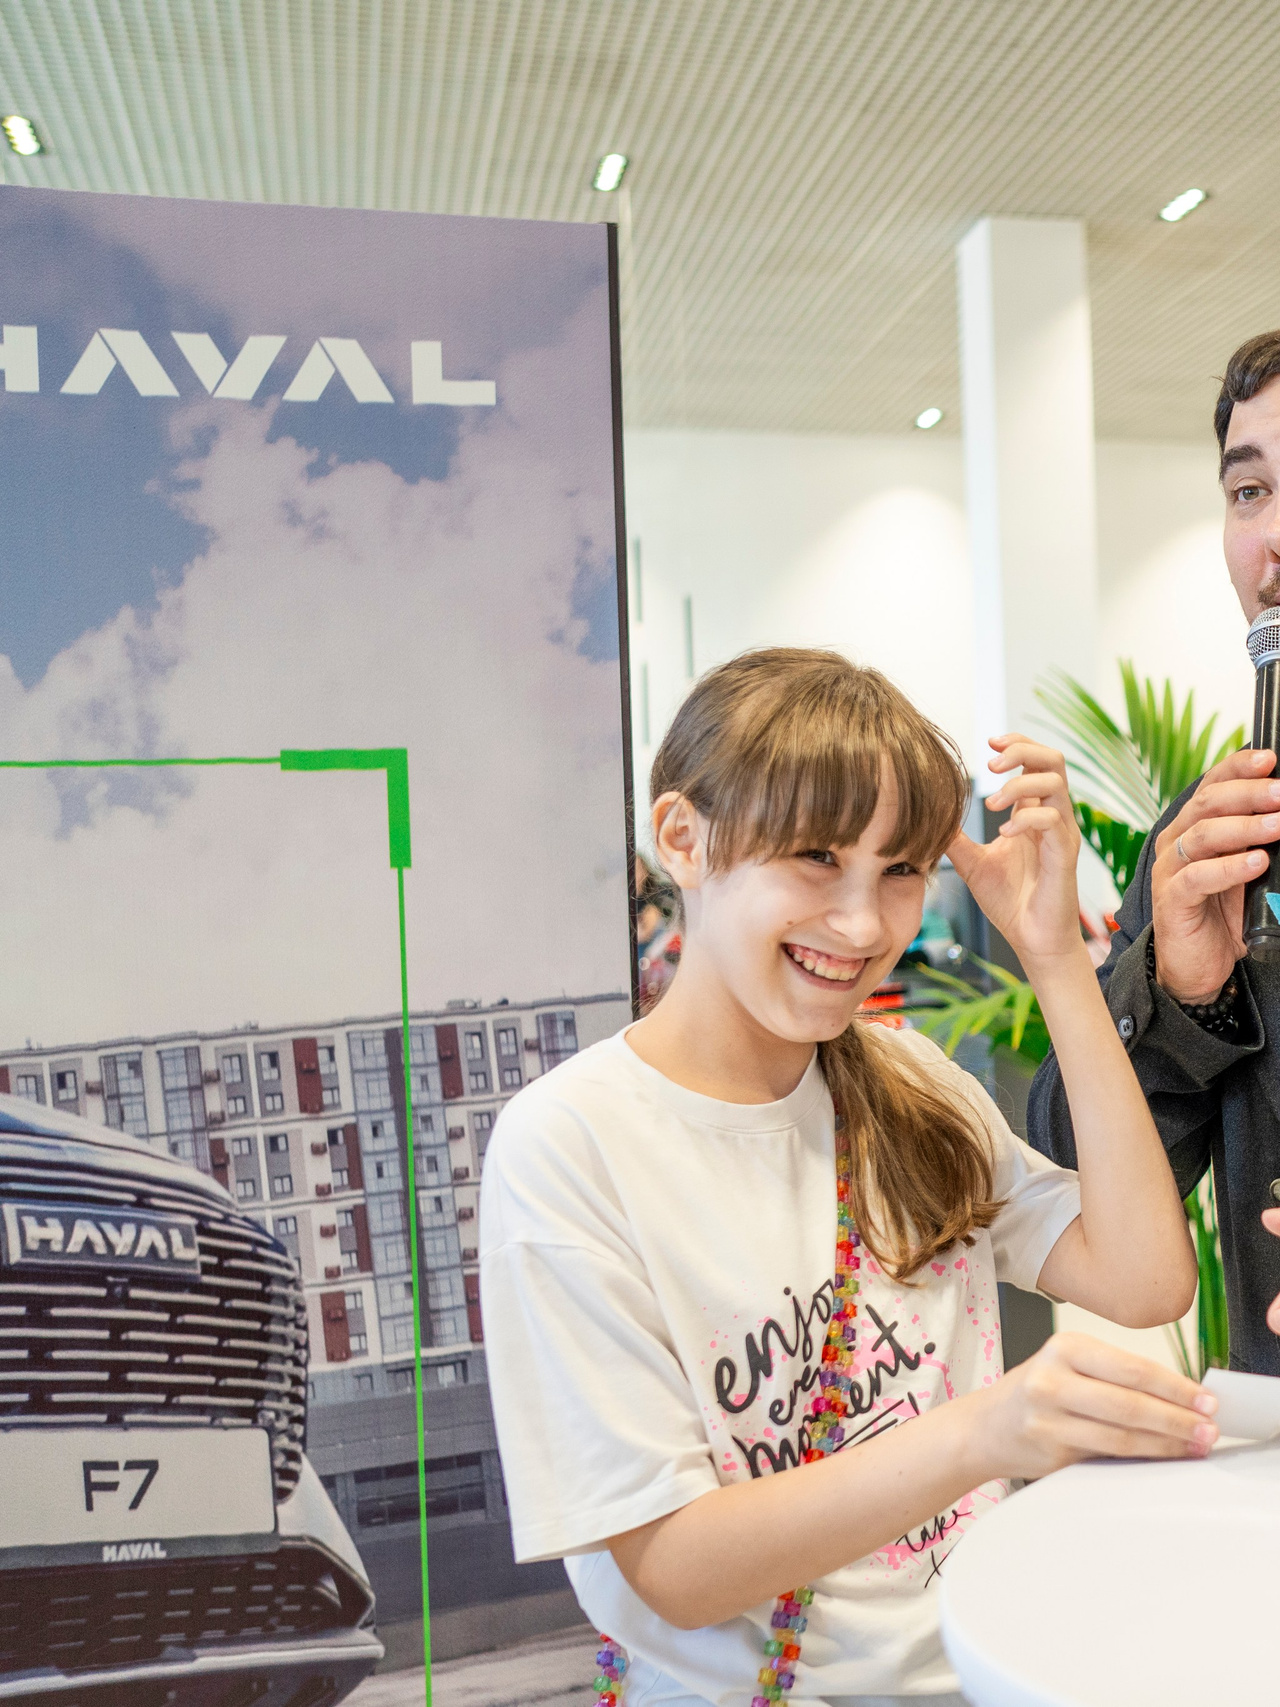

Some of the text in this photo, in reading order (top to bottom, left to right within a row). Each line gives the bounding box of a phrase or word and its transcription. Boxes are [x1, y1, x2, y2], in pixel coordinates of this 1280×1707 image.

[21, 1215, 198, 1261] HAVAL
[82, 1459, 159, 1512] F7
[102, 1542, 167, 1562] HAVAL
